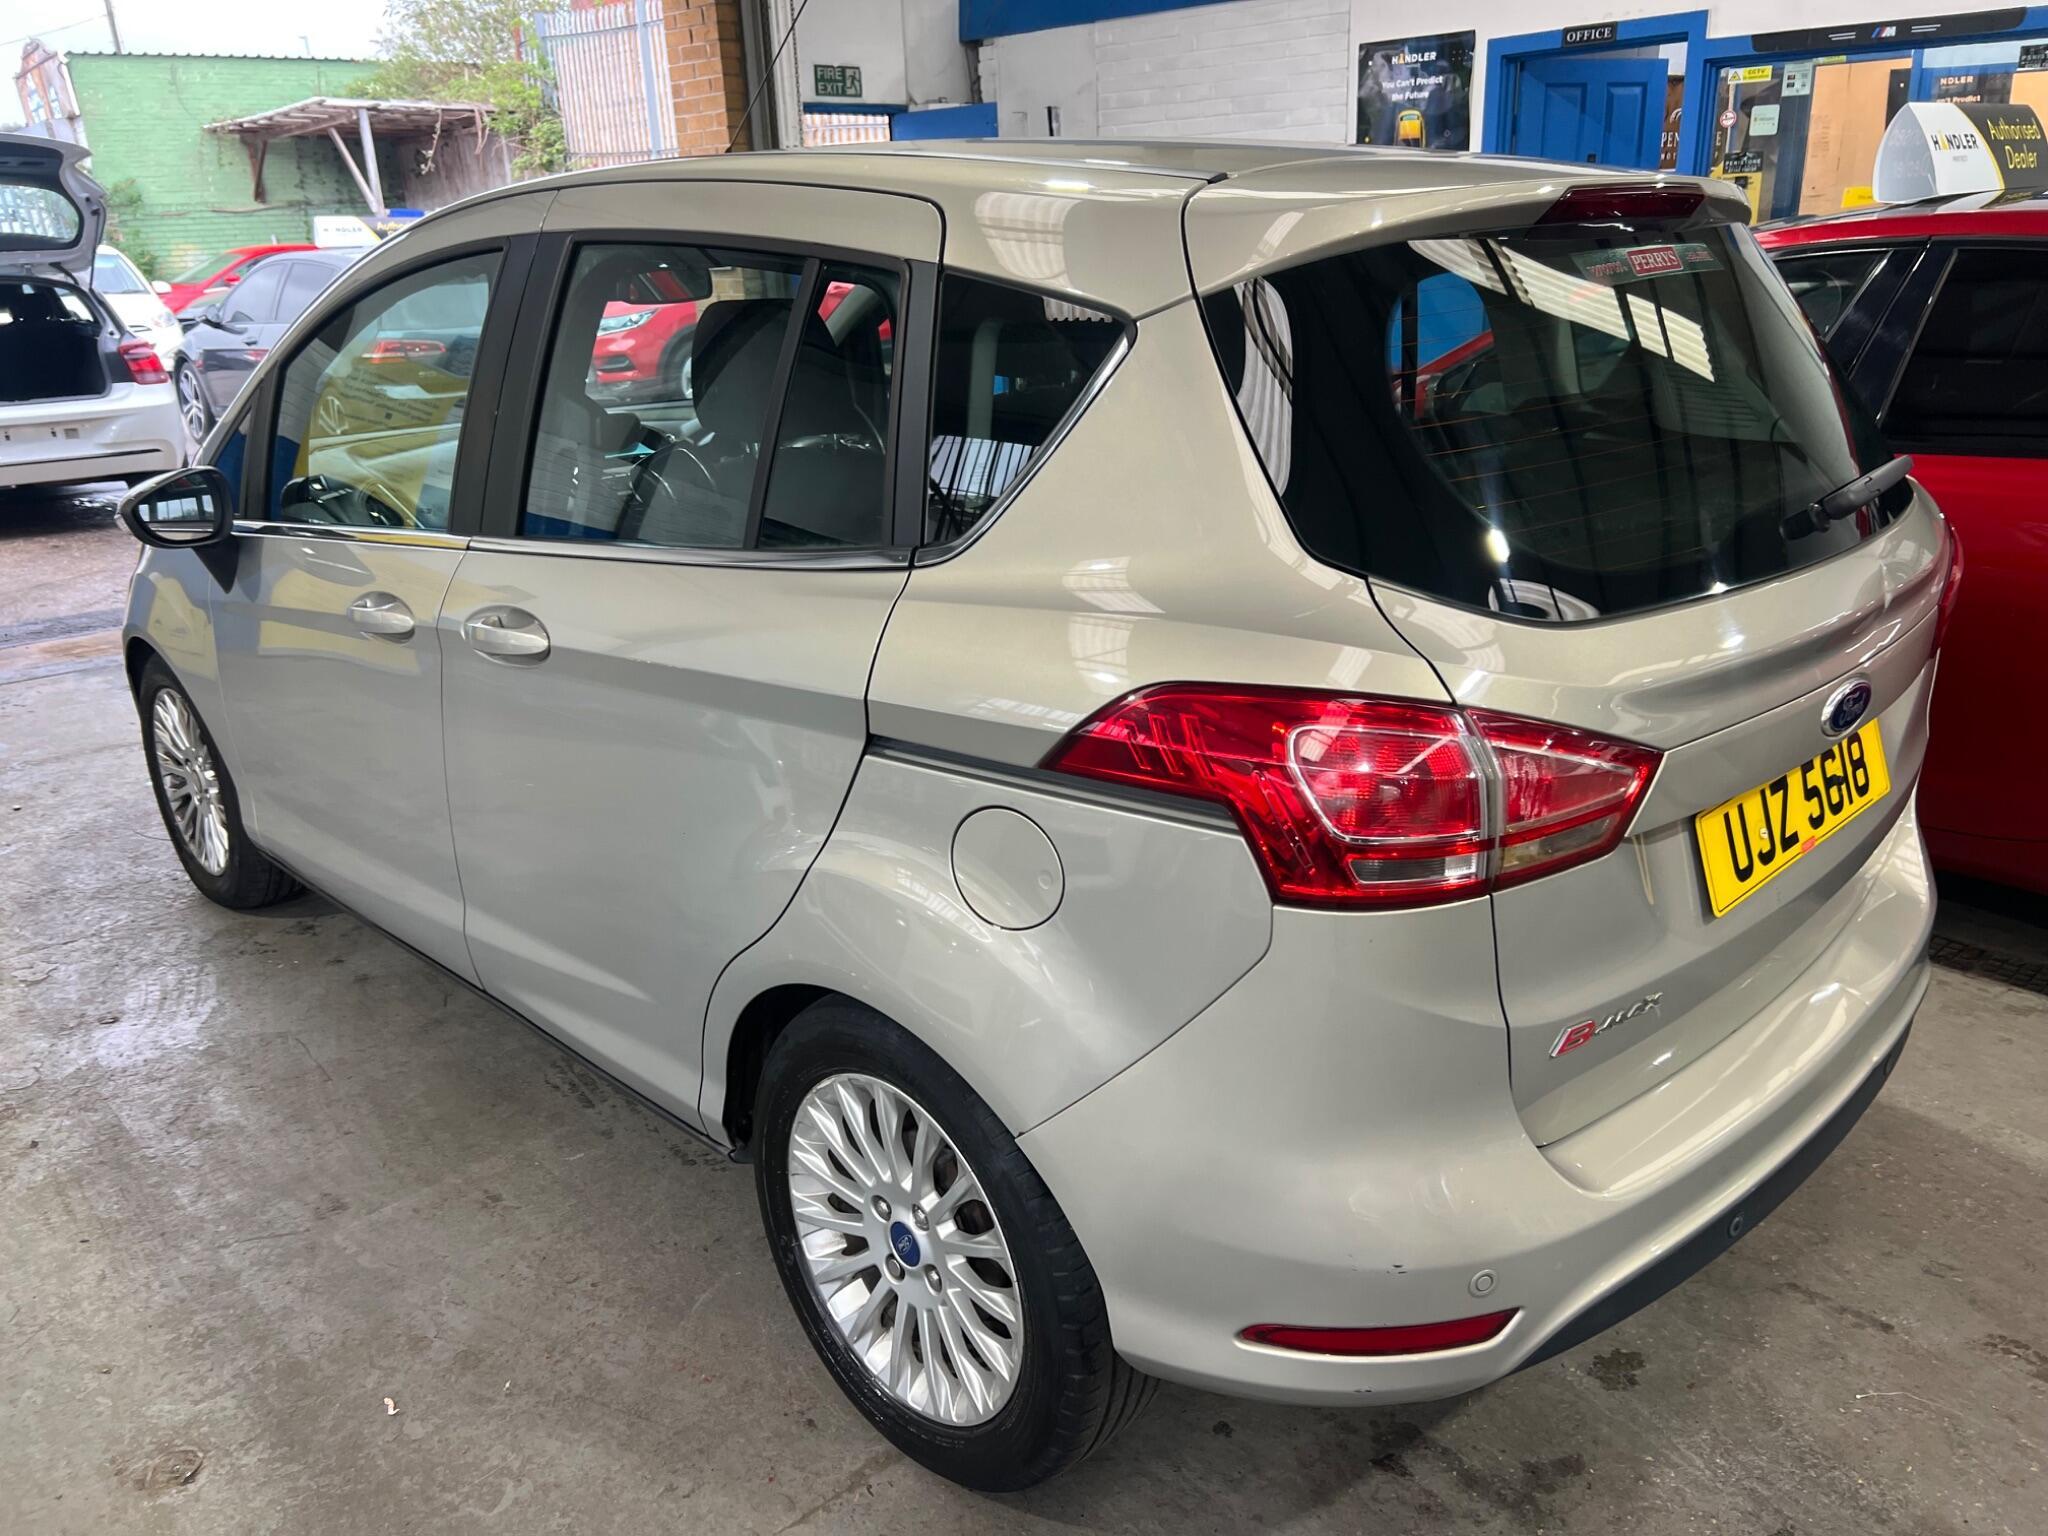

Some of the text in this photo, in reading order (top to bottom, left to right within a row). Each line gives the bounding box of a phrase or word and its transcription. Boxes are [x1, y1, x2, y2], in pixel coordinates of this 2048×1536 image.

[1566, 27, 1612, 42] OFFICE
[1392, 51, 1437, 64] HANDLER
[816, 67, 843, 80] FIRE
[1940, 76, 1974, 85] NDLER
[817, 82, 844, 95] EXIT
[1382, 75, 1443, 89] You Can't Predict
[1392, 91, 1429, 101] the Future
[1986, 118, 2041, 140] Authorised
[1661, 131, 1680, 147] PEN
[1931, 130, 1978, 150] HANDLER
[2005, 145, 2038, 169] Dealer
[1630, 250, 1679, 271] PERRYS
[1723, 732, 1870, 882] UJZ 5618
